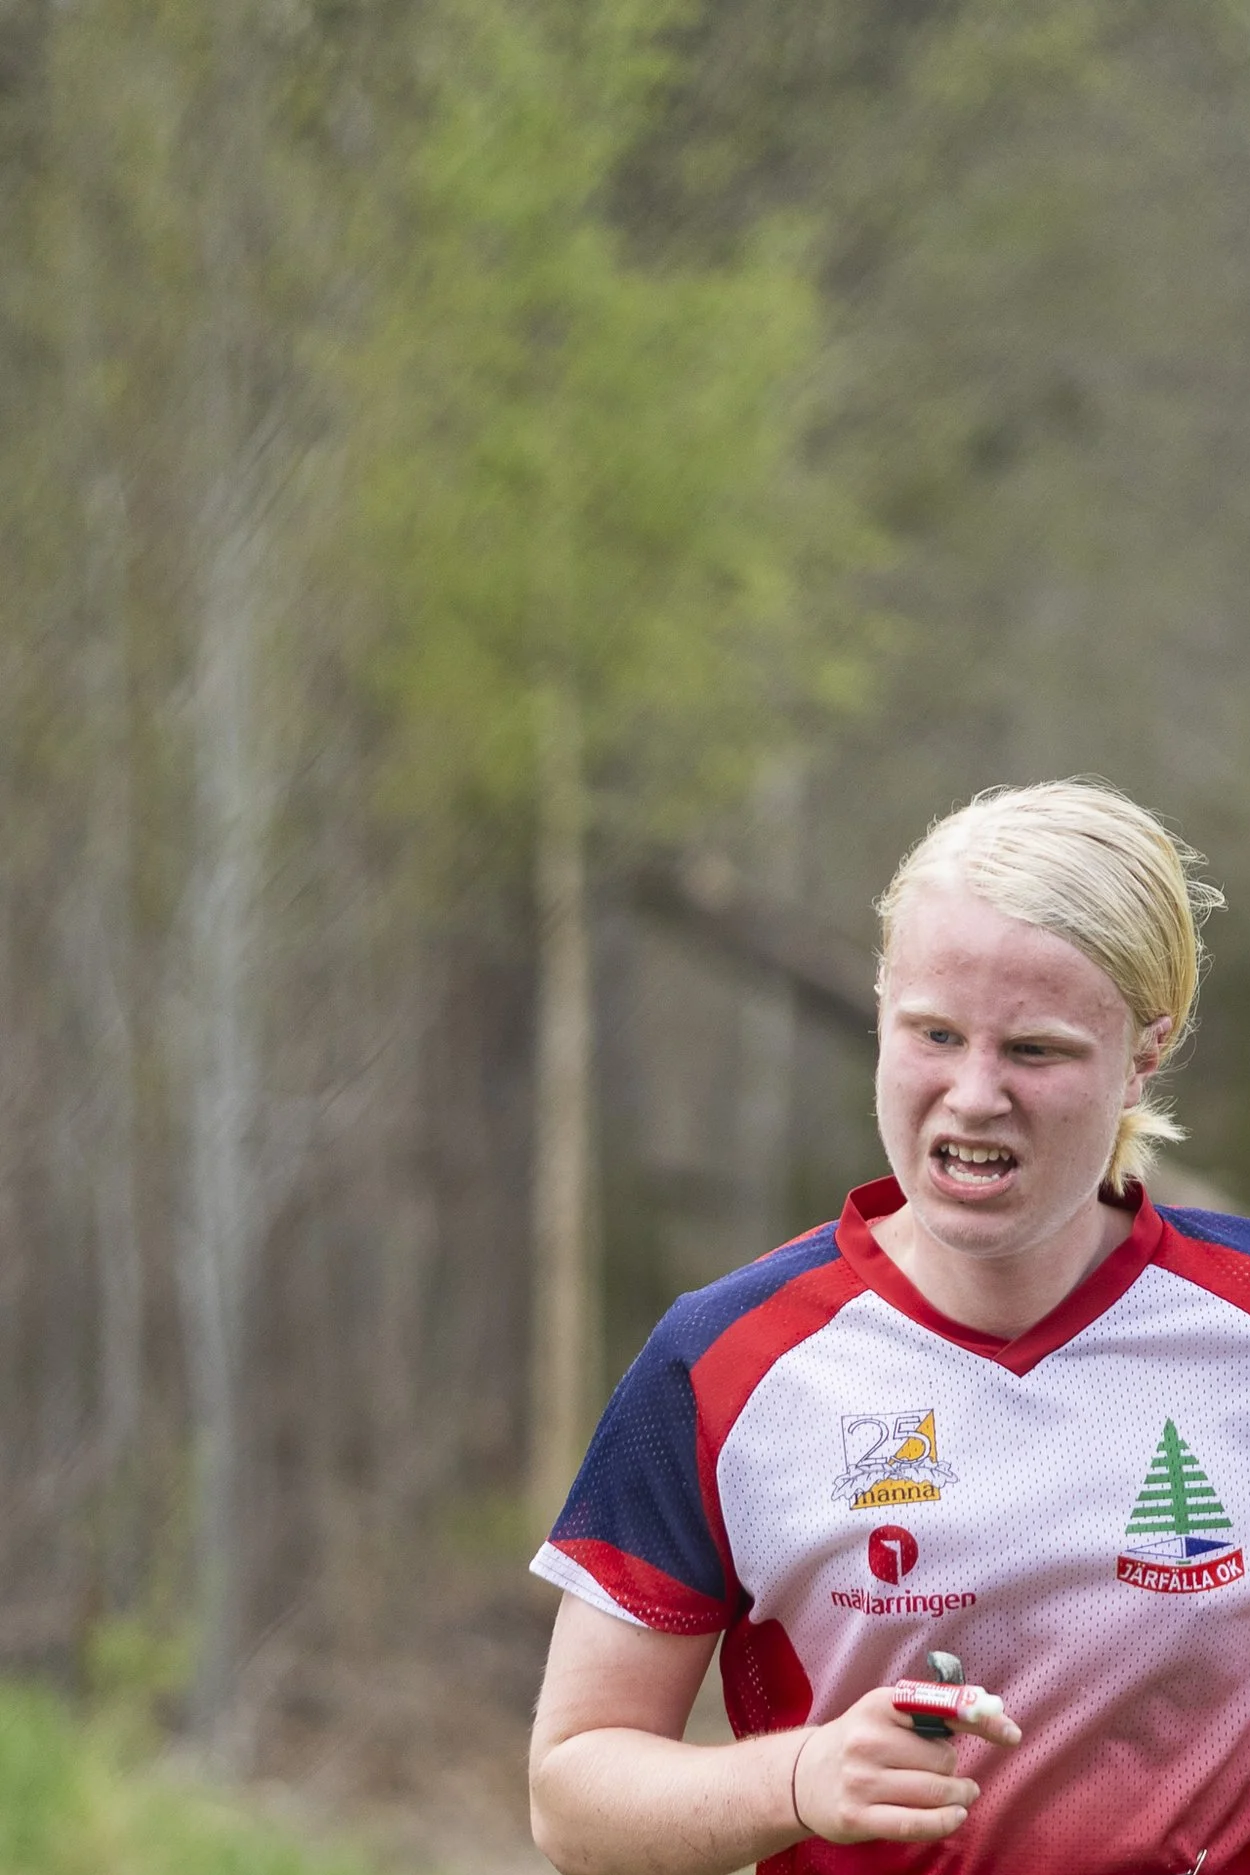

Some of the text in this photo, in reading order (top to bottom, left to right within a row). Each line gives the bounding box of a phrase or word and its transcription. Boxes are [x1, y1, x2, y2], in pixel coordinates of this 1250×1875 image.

[848, 1416, 931, 1467] 25
[854, 1486, 935, 1506] manna
[1119, 1558, 1243, 1591] JÄRFÄLLA OK
